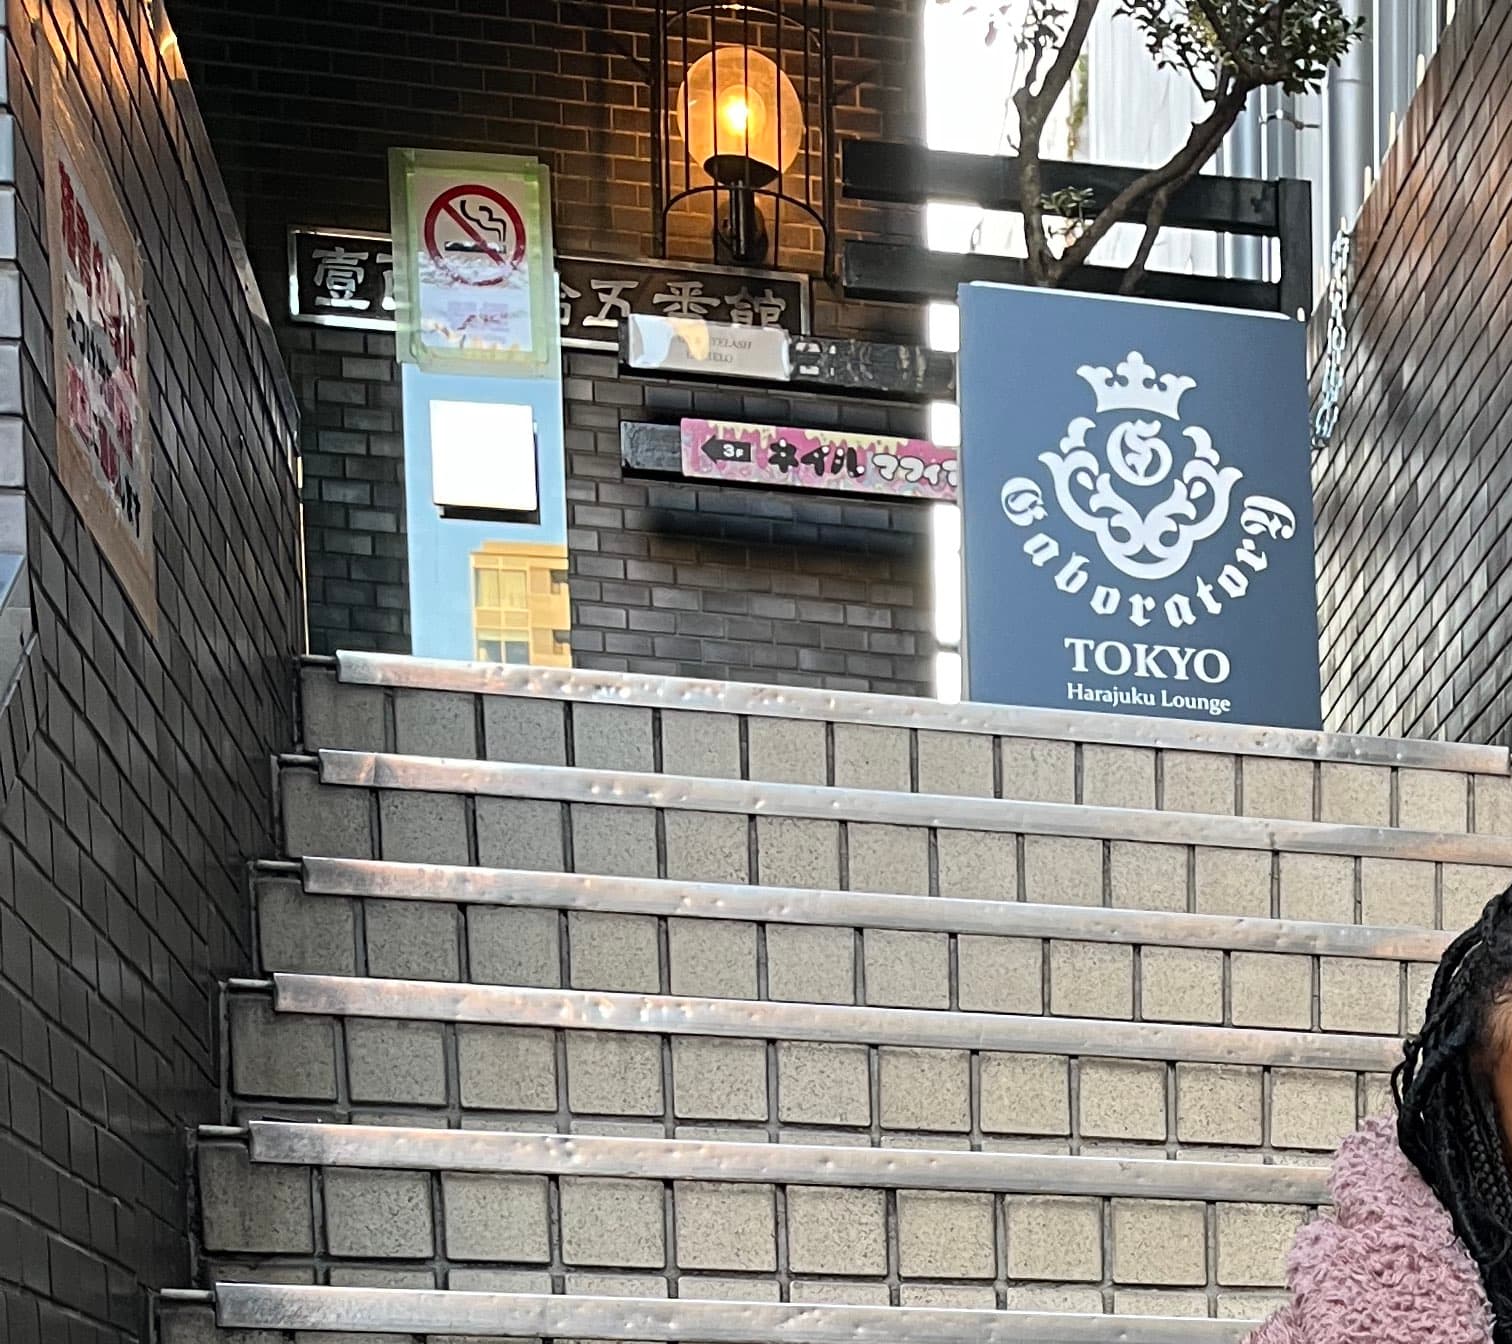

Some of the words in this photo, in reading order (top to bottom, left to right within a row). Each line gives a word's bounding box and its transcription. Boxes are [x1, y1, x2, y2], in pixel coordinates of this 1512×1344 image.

[1063, 637, 1231, 684] TOKYO
[1067, 682, 1156, 708] Harajuku
[1161, 689, 1231, 716] Lounge
